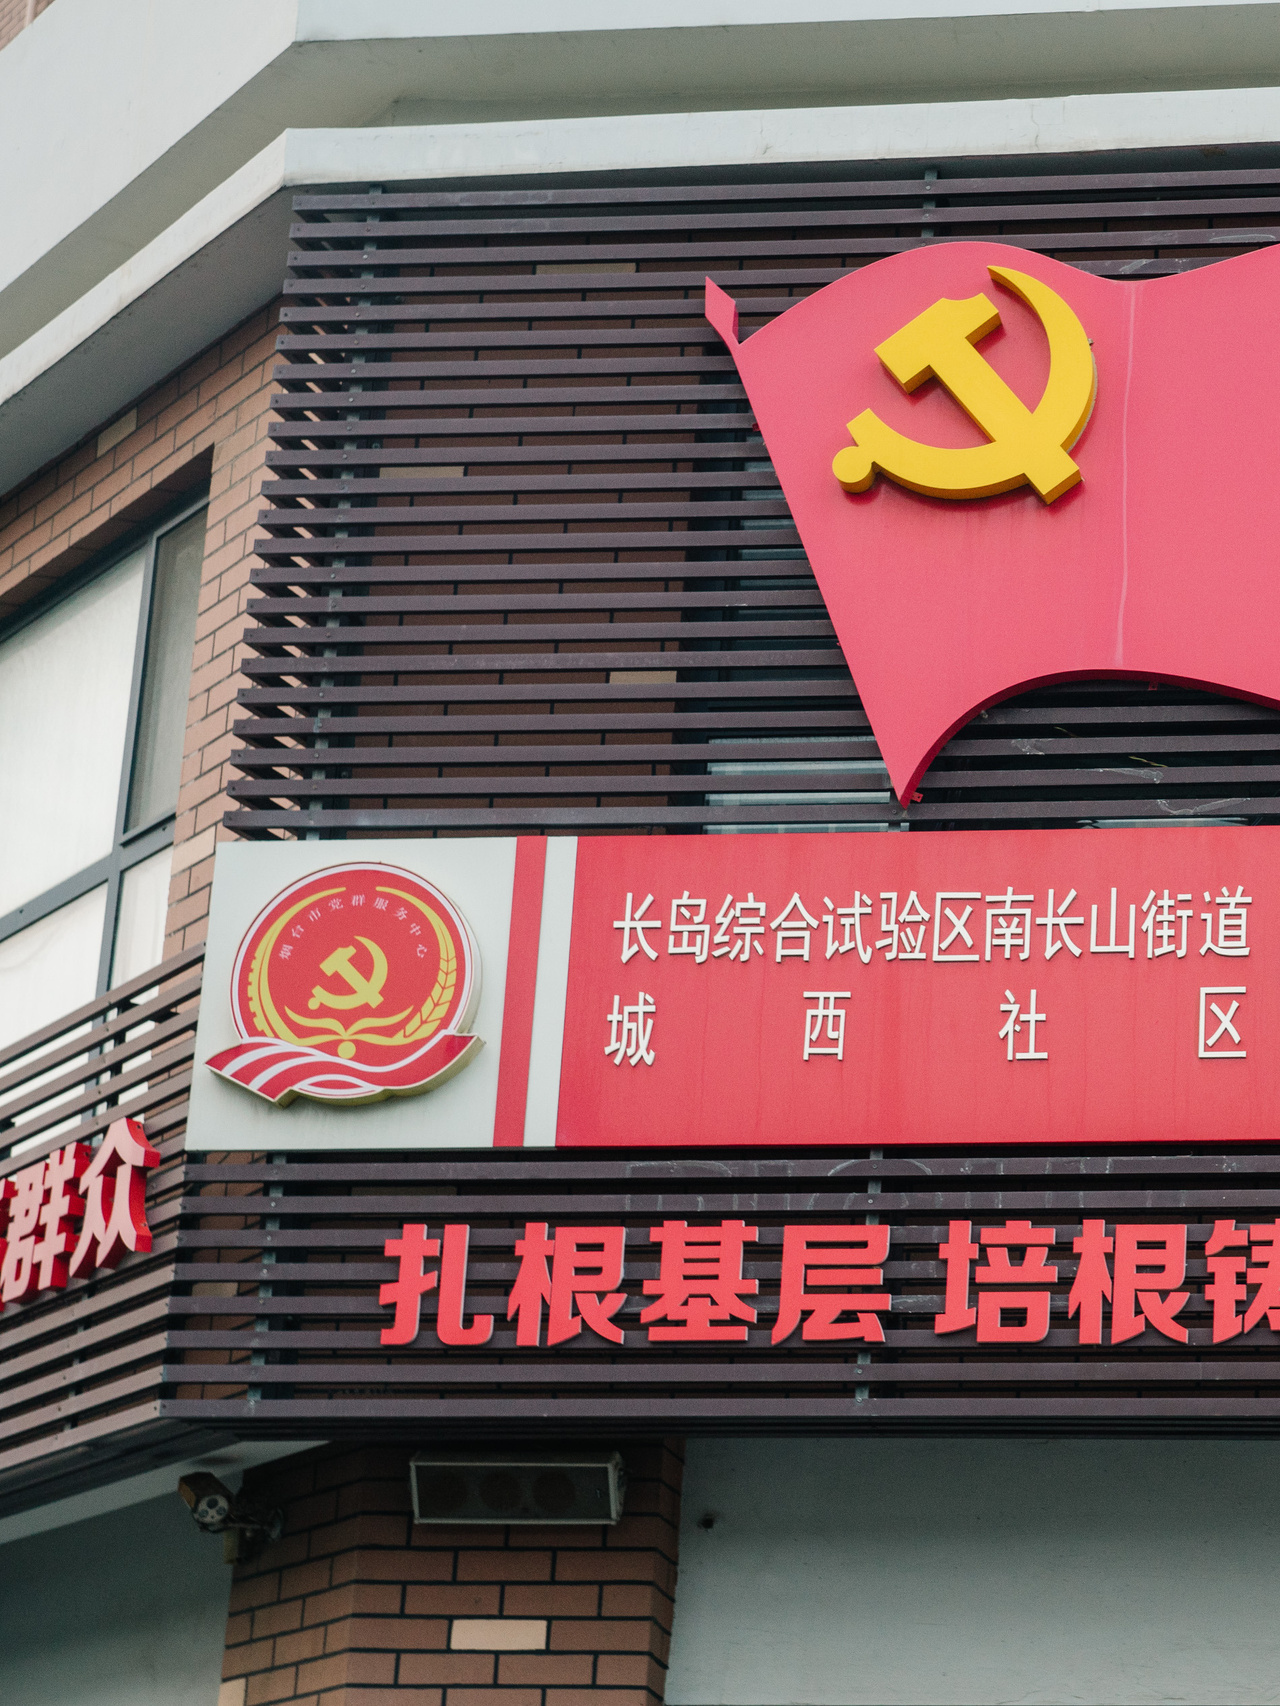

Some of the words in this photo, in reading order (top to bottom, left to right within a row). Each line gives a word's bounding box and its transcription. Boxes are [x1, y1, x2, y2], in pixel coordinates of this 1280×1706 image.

[278, 894, 425, 960] 烟台市党群服务中心
[613, 886, 1252, 964] 长岛综合试验区南长山街道
[604, 986, 1247, 1066] 城西社区
[0, 1117, 160, 1310] 群众
[379, 1220, 892, 1347] 扎根基层
